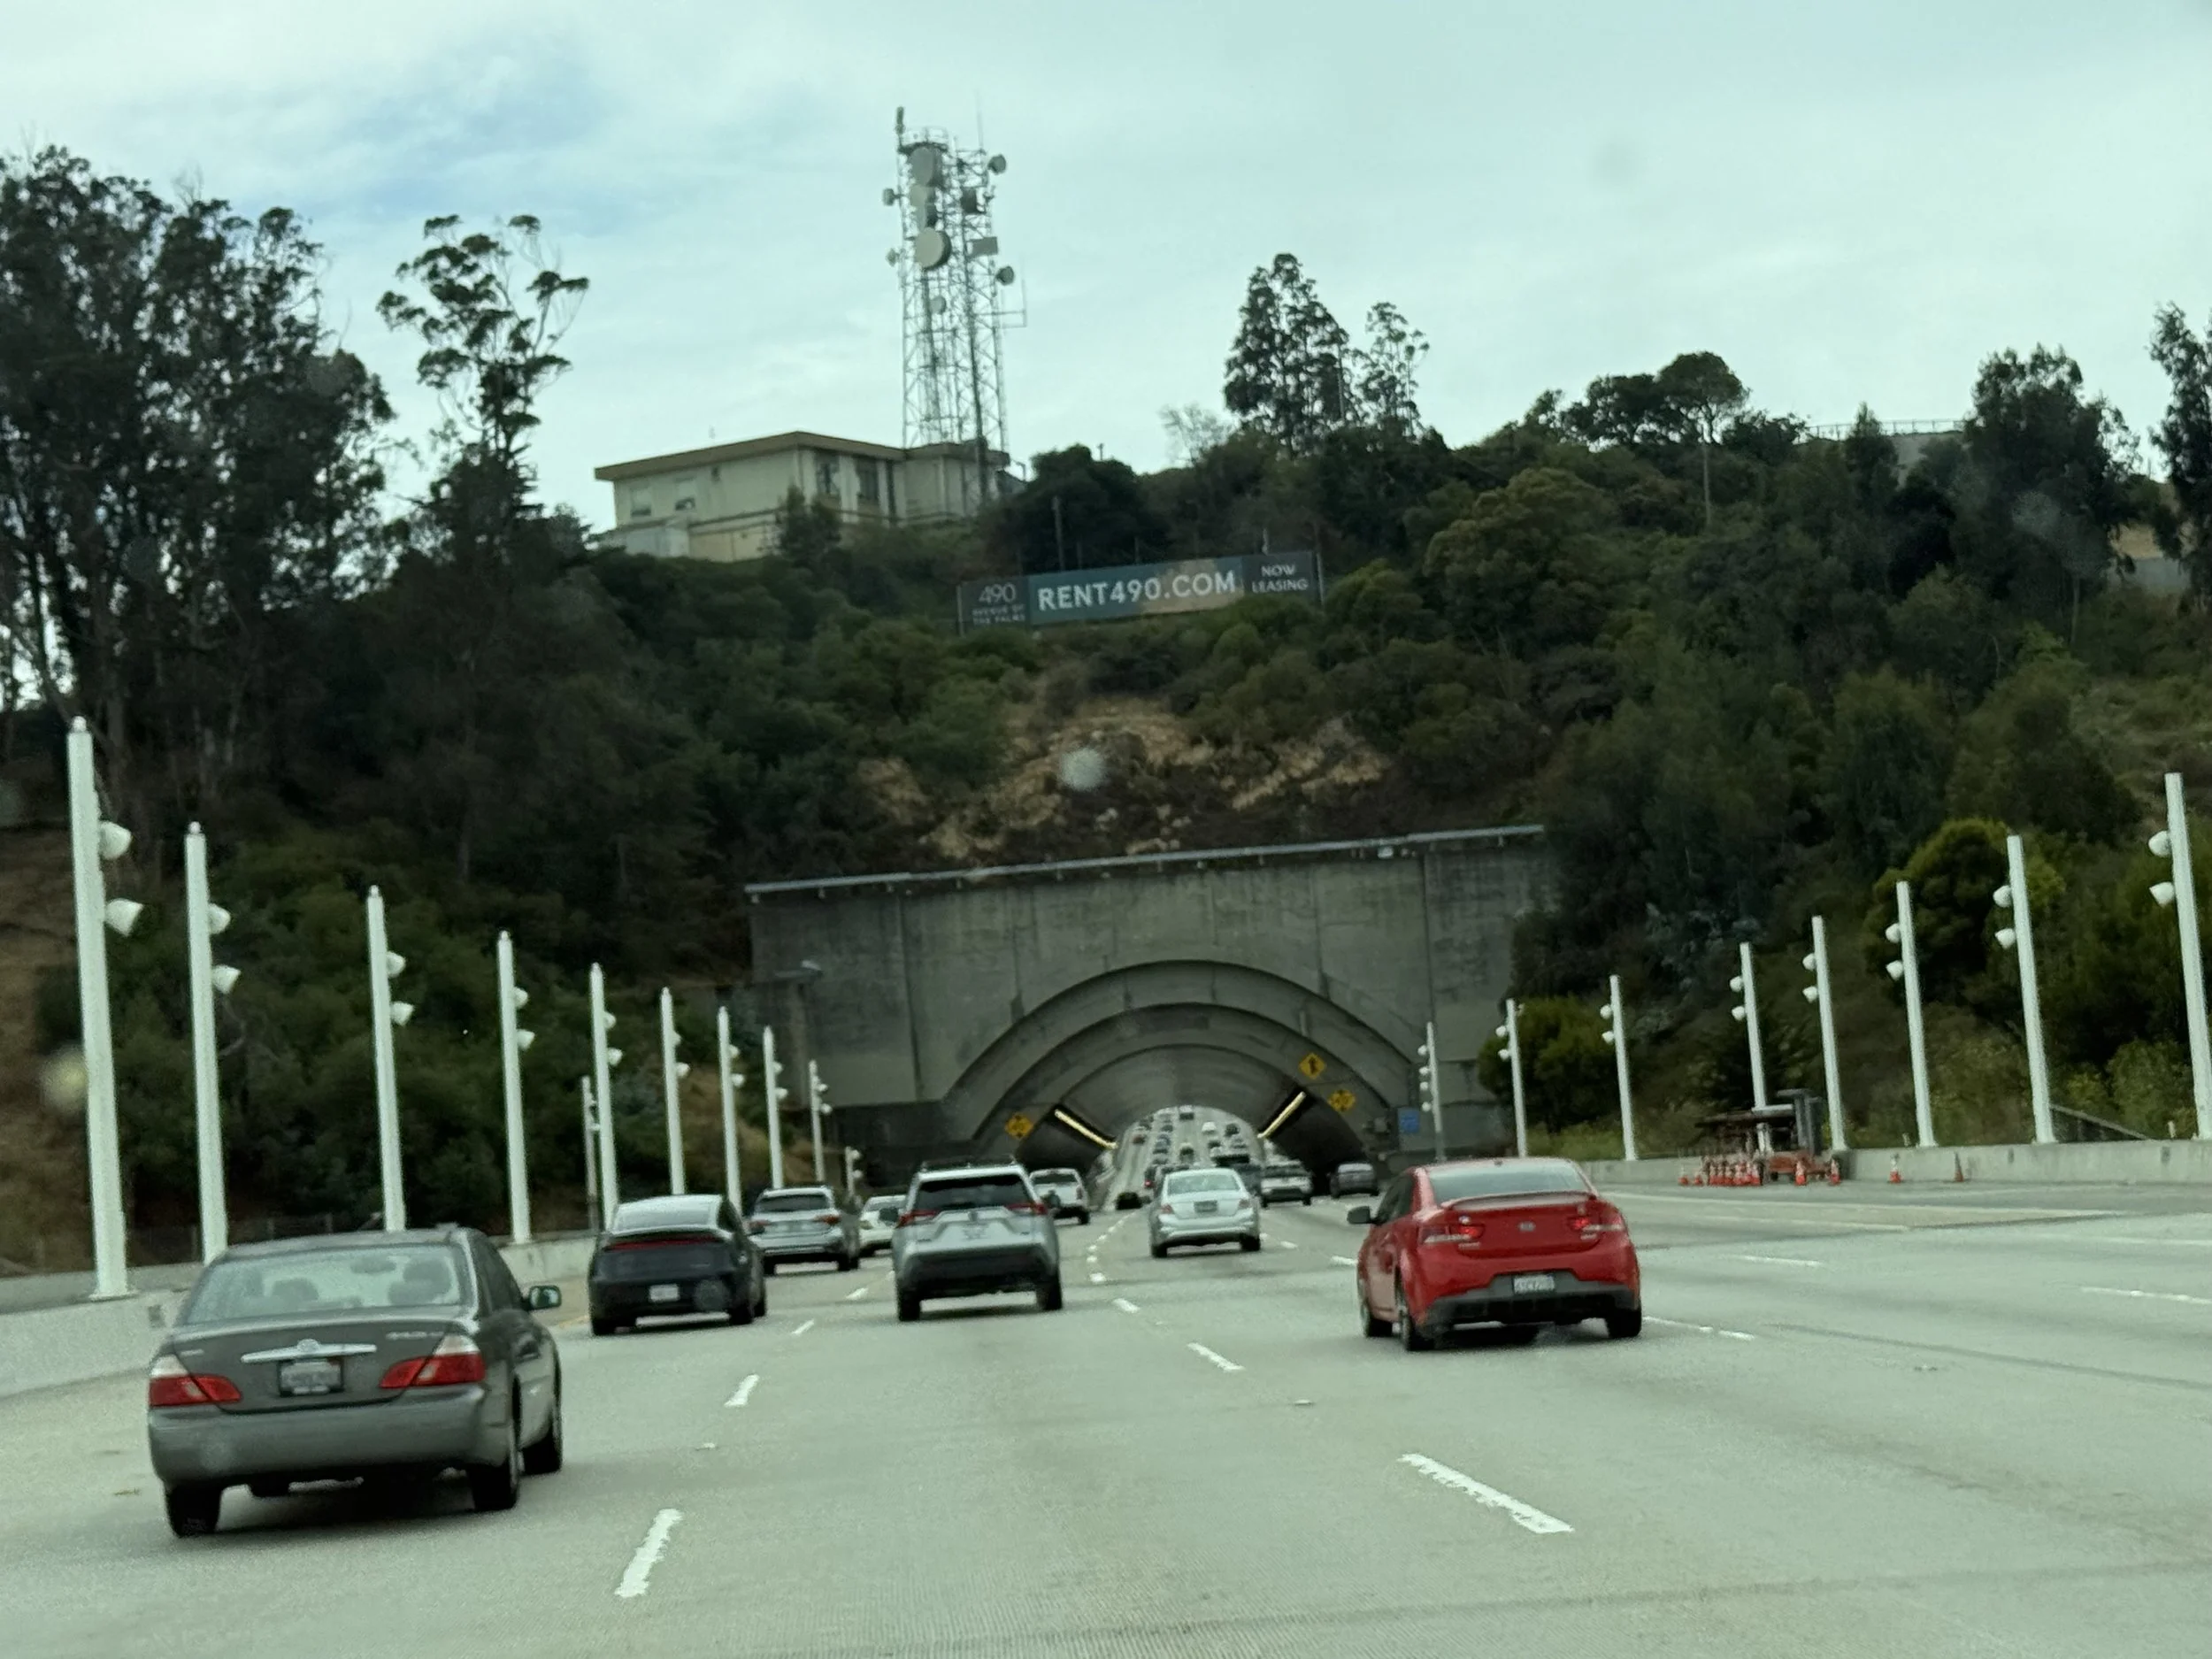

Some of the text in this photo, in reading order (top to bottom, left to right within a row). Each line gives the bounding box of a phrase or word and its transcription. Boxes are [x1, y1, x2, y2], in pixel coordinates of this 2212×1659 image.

[1261, 564, 1297, 577] NOW
[979, 582, 1017, 603] 490
[1037, 569, 1236, 611] RENT490.COM
[1252, 578, 1310, 594] LEASING
